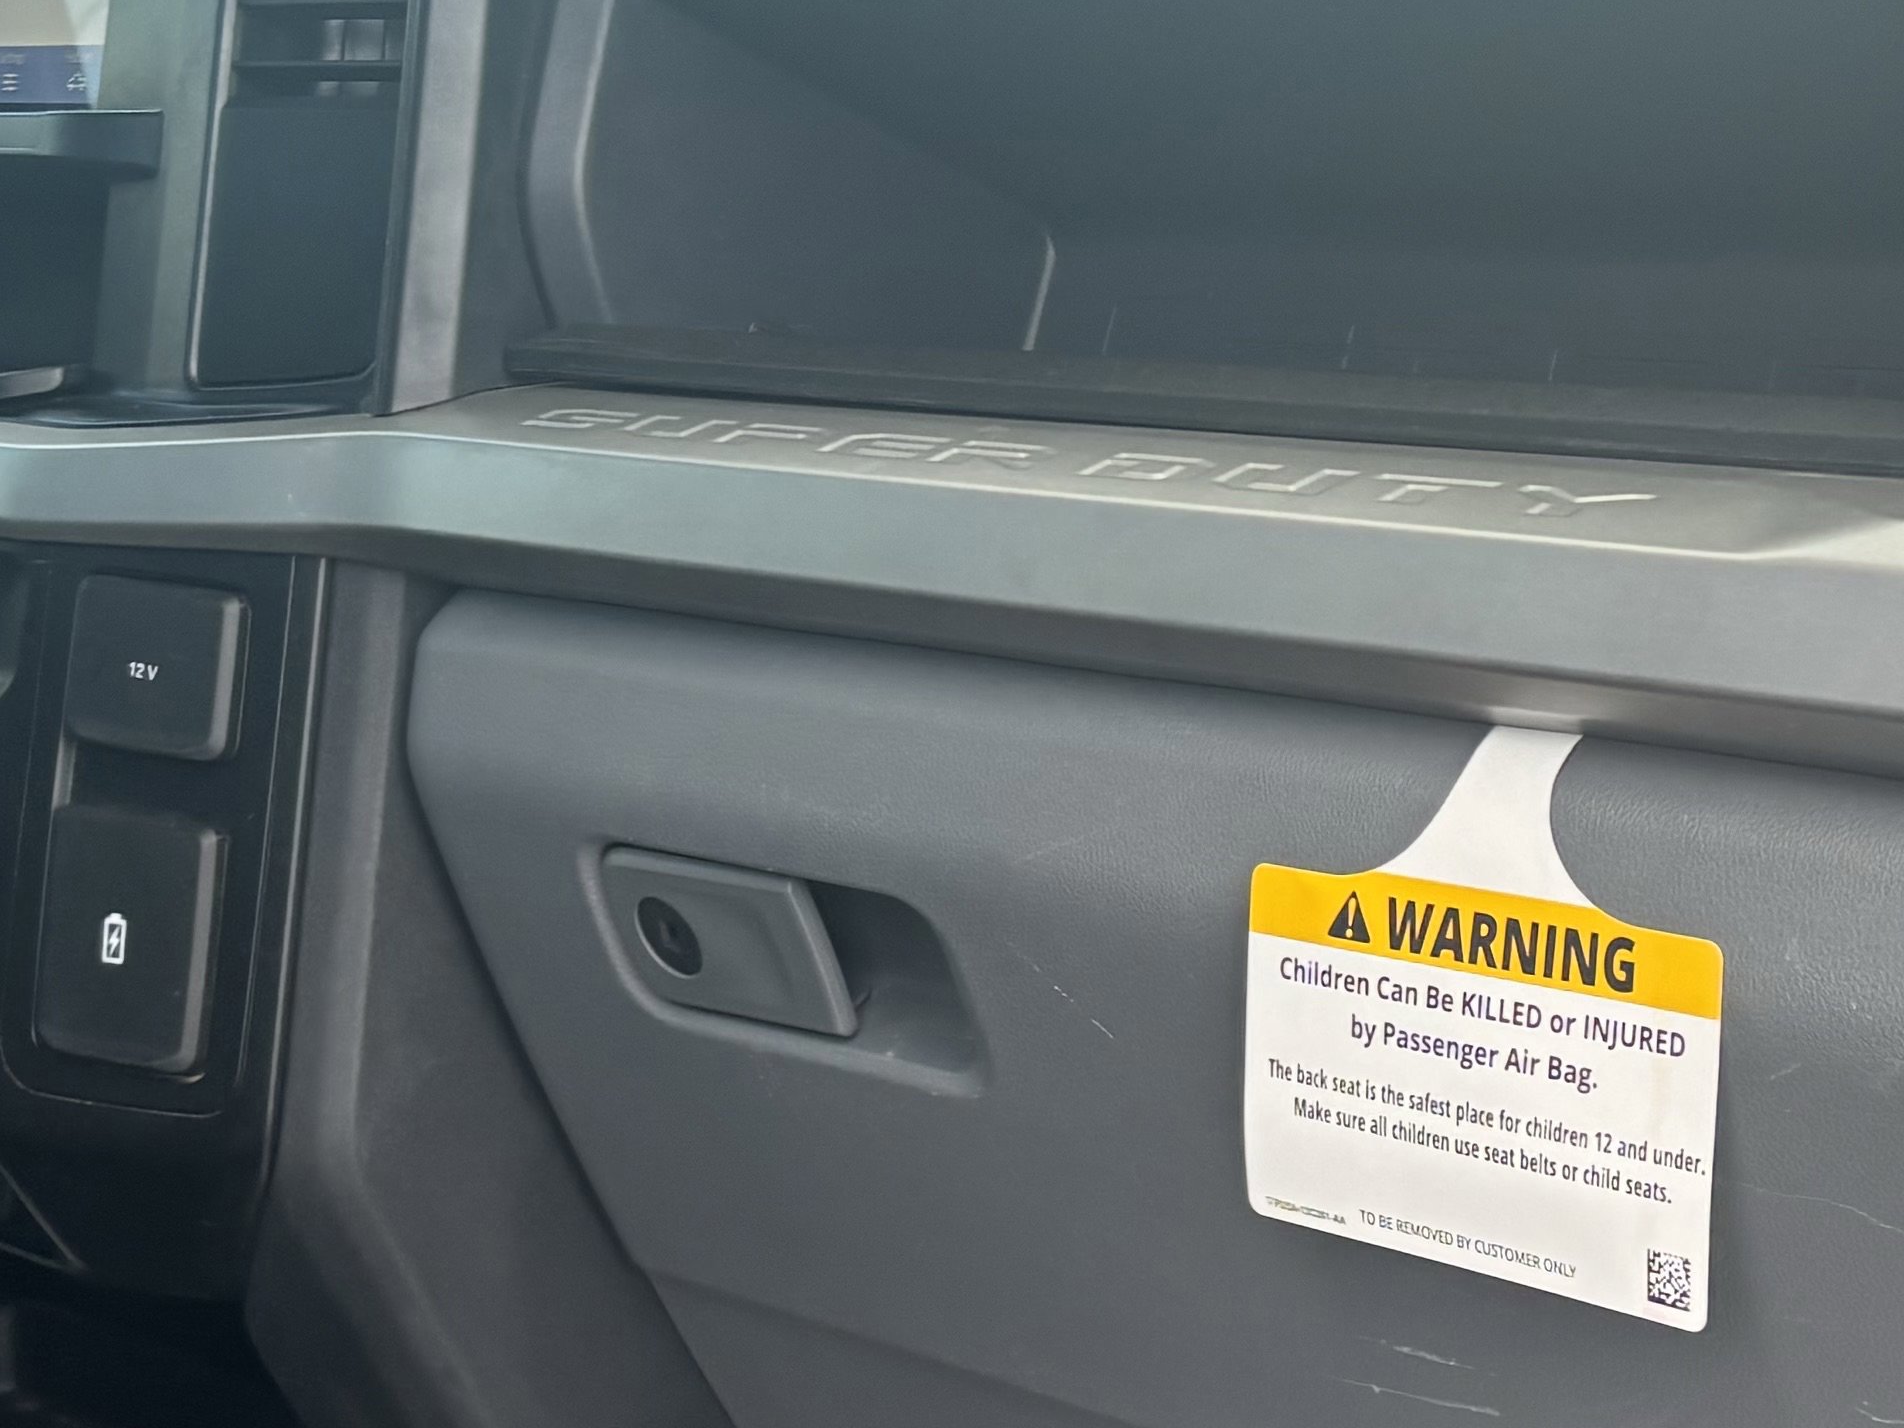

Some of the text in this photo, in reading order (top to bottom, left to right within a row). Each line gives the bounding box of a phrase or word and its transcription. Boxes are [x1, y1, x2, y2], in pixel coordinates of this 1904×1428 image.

[1080, 452, 1658, 517] DUTY
[1388, 897, 1636, 993] WARNING
[1280, 957, 1686, 1058] Children Can Be KILLED or INJURED
[1351, 1013, 1598, 1094] by Passenger Air Bag.
[1268, 1058, 1706, 1176] The back seat is the safest place for children 12 and under.
[1293, 1097, 1672, 1204] Make sure all children use seat belts or child seats.
[1359, 1209, 1376, 1226] TO
[1379, 1215, 1394, 1231] BE
[1396, 1219, 1453, 1246] REMOVED
[1456, 1234, 1471, 1251] BY
[1474, 1239, 1541, 1270] CUSTOMER
[1543, 1258, 1576, 1278] ONLY
